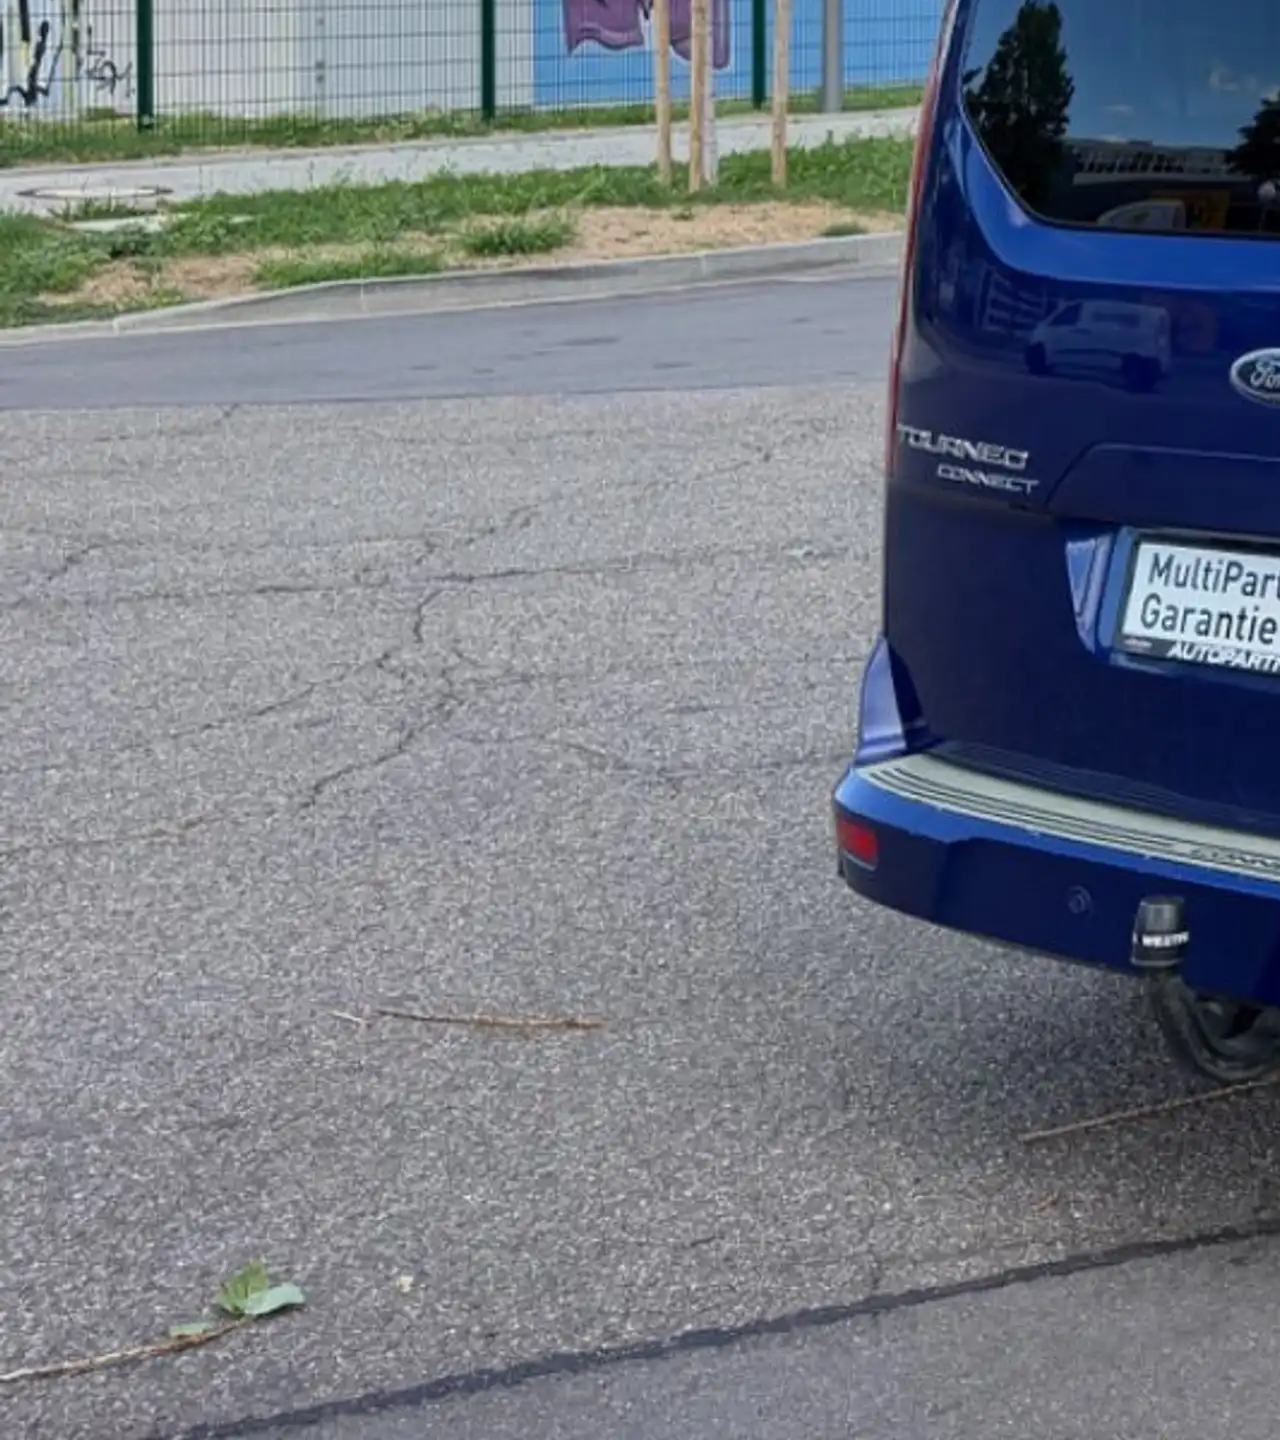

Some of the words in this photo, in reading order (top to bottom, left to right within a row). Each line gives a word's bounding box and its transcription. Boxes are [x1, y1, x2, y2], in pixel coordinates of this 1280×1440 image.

[896, 423, 1029, 470] TOURNEO
[937, 463, 1039, 495] CONNECT
[1140, 592, 1278, 646] Garantie
